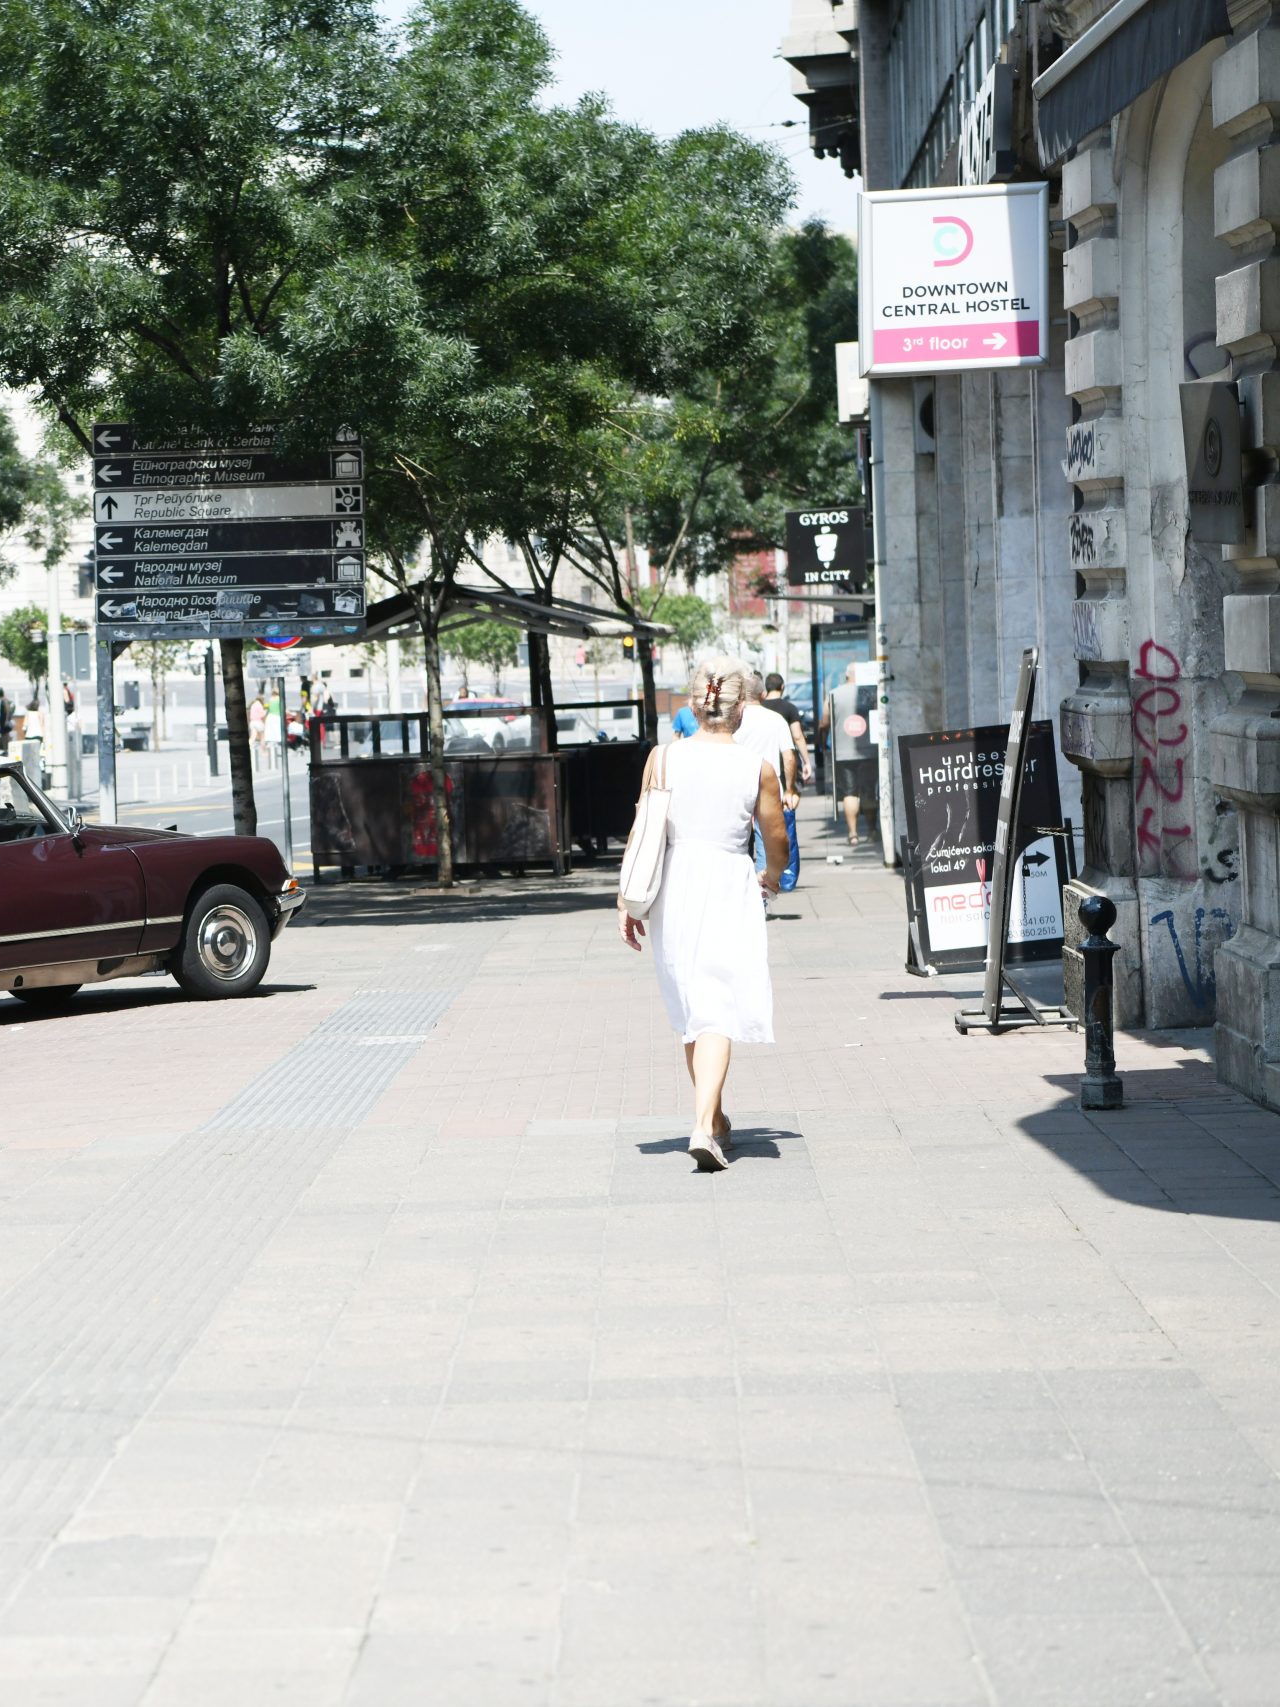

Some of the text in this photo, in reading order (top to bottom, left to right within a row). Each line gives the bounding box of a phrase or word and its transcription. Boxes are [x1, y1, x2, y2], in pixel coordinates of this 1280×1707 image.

[902, 281, 1008, 298] DOWNTOWN
[882, 298, 1031, 317] CENTRAL HOSTEL
[902, 336, 969, 352] 3rd floor
[219, 457, 253, 469] музеј
[132, 471, 266, 486] Ethnographic Museum
[133, 494, 153, 506] Трг
[134, 506, 232, 520] Republic Square
[799, 511, 849, 526] GYROS
[133, 528, 209, 540] Калемегдан
[134, 541, 208, 553] Kalemegdan
[134, 560, 223, 573] Народни музеј
[134, 574, 237, 586] National Museum
[804, 569, 851, 583] IN CITY
[135, 595, 188, 608] Народно
[919, 758, 1037, 784] Hairdresr
[930, 859, 966, 874] lokal 49
[966, 910, 991, 922] salo
